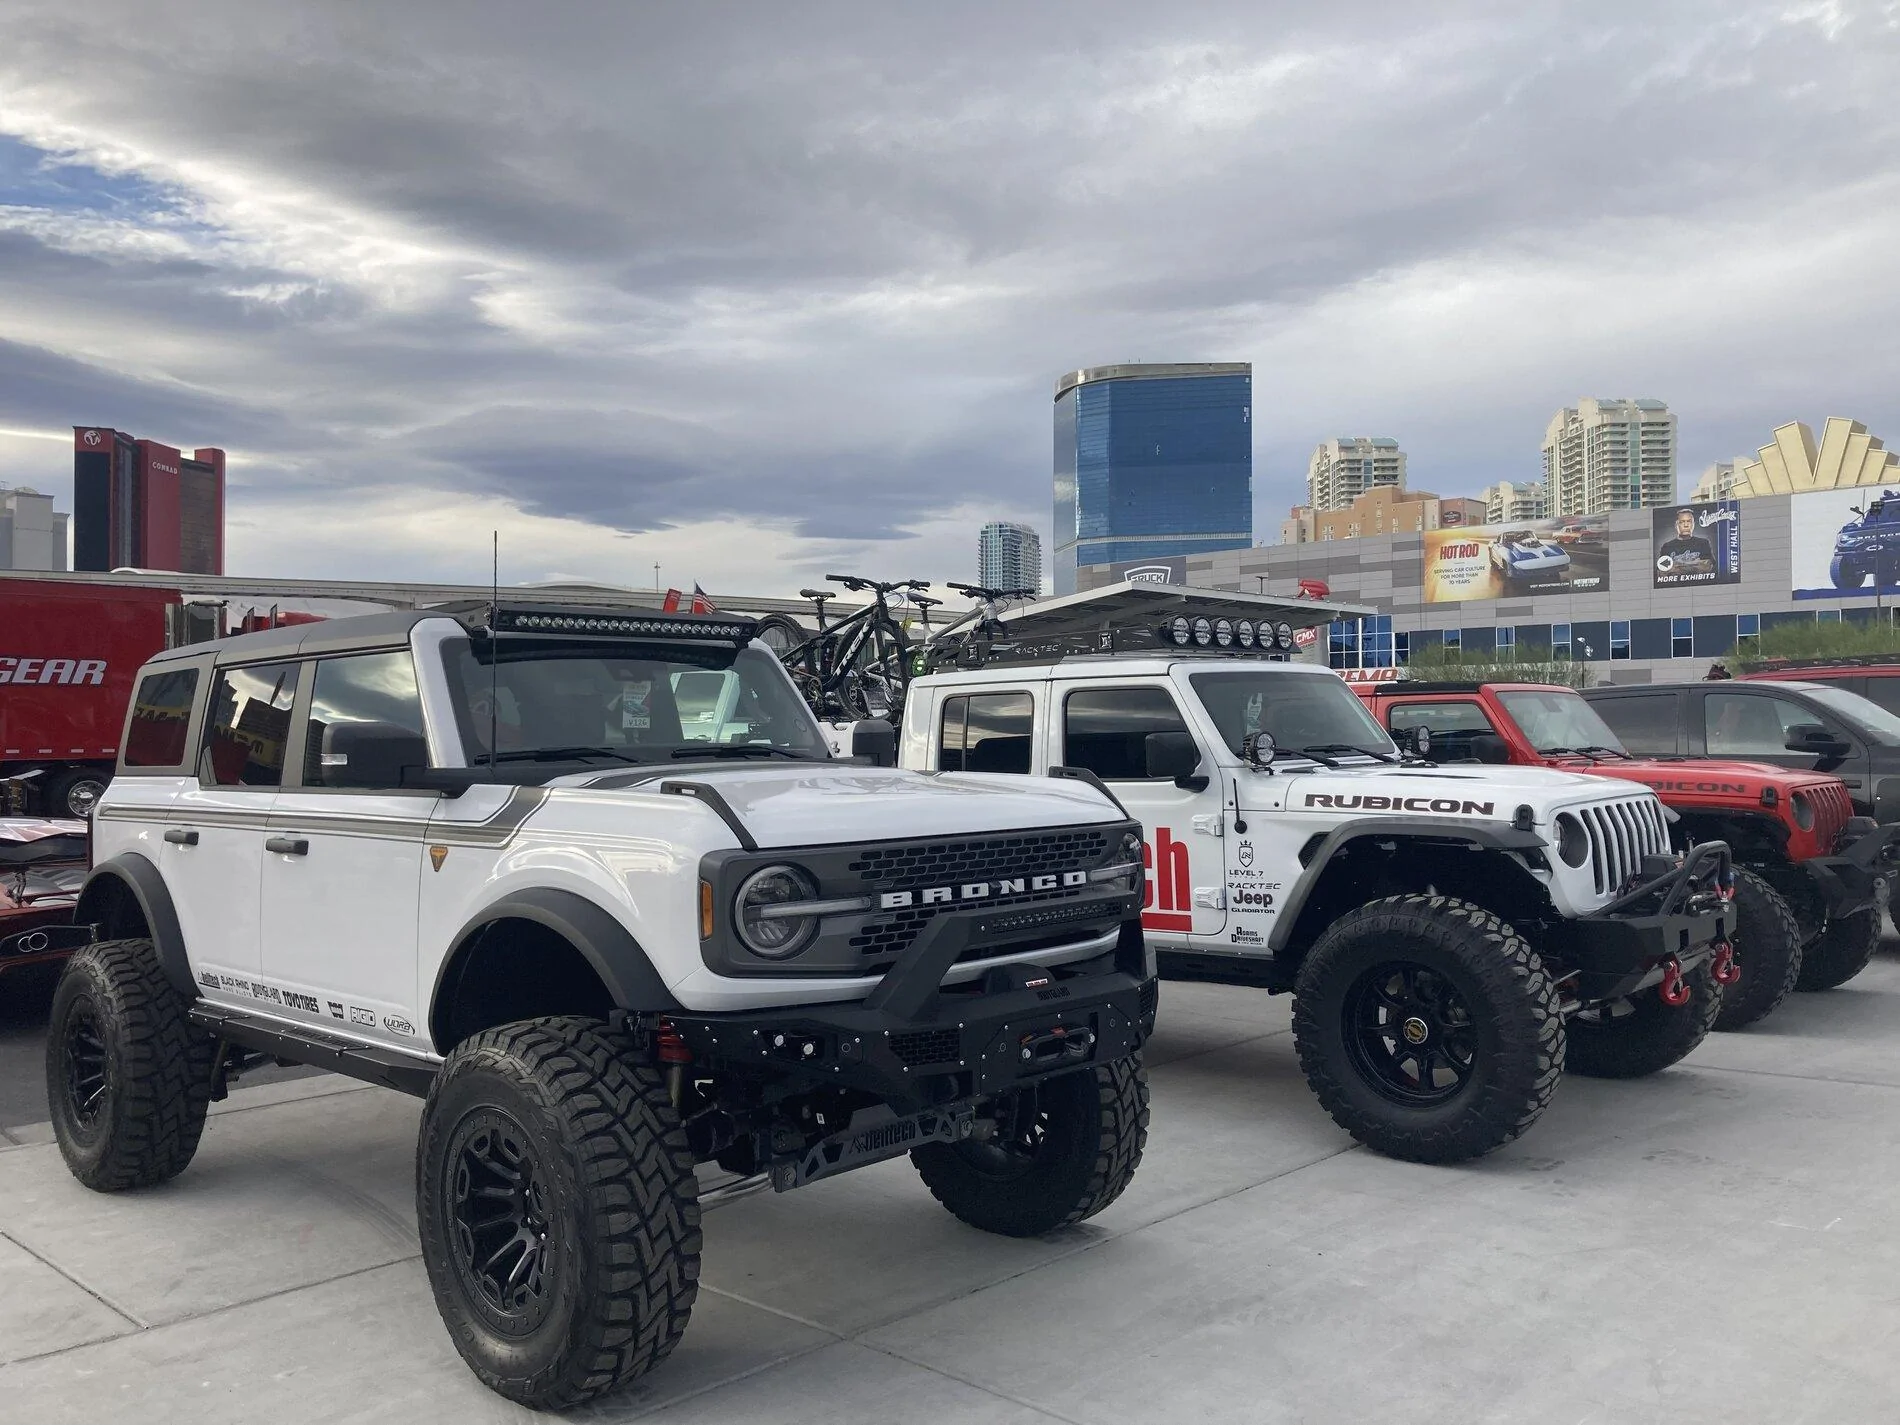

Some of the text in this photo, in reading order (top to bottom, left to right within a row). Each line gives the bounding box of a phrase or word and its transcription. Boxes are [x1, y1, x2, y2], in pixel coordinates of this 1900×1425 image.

[152, 461, 178, 475] CONRAD
[1730, 525, 1738, 574] WEST HALL
[1657, 572, 1716, 583] MORE EXHIBITS
[1296, 629, 1316, 644] CMX
[1304, 793, 1496, 816] RUBICON
[1229, 869, 1256, 877] LEVEL
[880, 870, 1087, 909] BRONCO
[1227, 882, 1282, 890] RACKTEC
[1233, 889, 1273, 908] Jeep
[1231, 907, 1276, 915] GLADIATOR
[1231, 933, 1264, 943] DRIVESHAFT
[220, 975, 235, 986] BLACK
